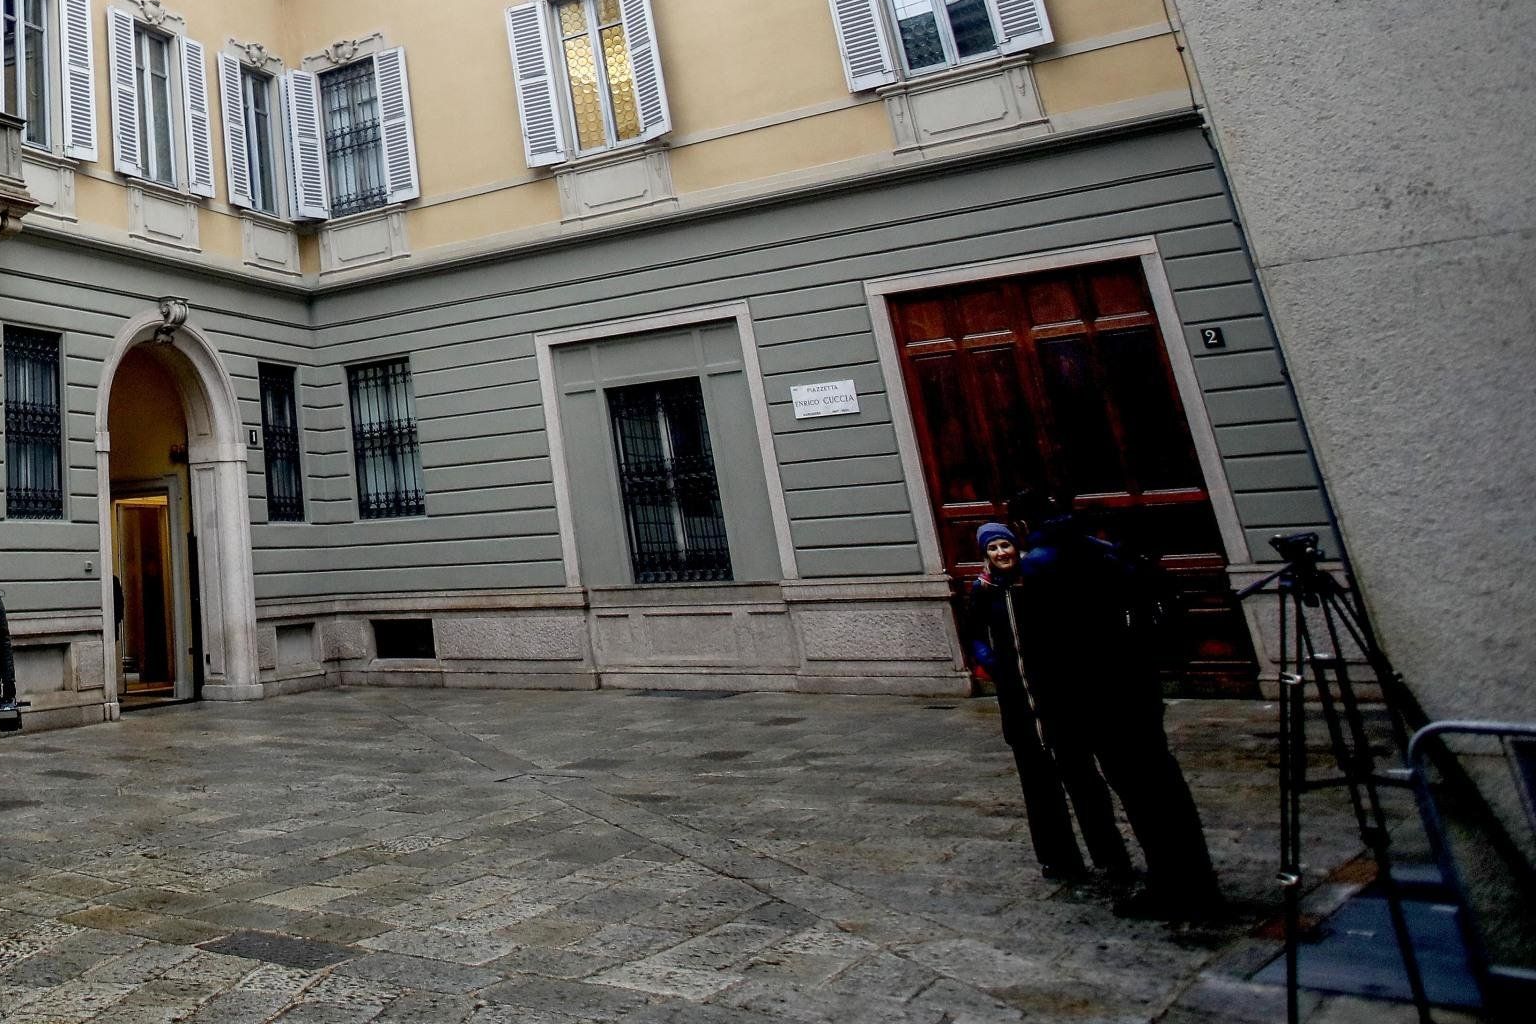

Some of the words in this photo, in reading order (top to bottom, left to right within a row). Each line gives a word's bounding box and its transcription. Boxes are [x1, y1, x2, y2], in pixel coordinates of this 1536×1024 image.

[1205, 329, 1218, 344] 2
[806, 384, 838, 393] PIAZZETTA
[794, 399, 820, 408] ENRICO
[822, 394, 855, 405] CUCCIA
